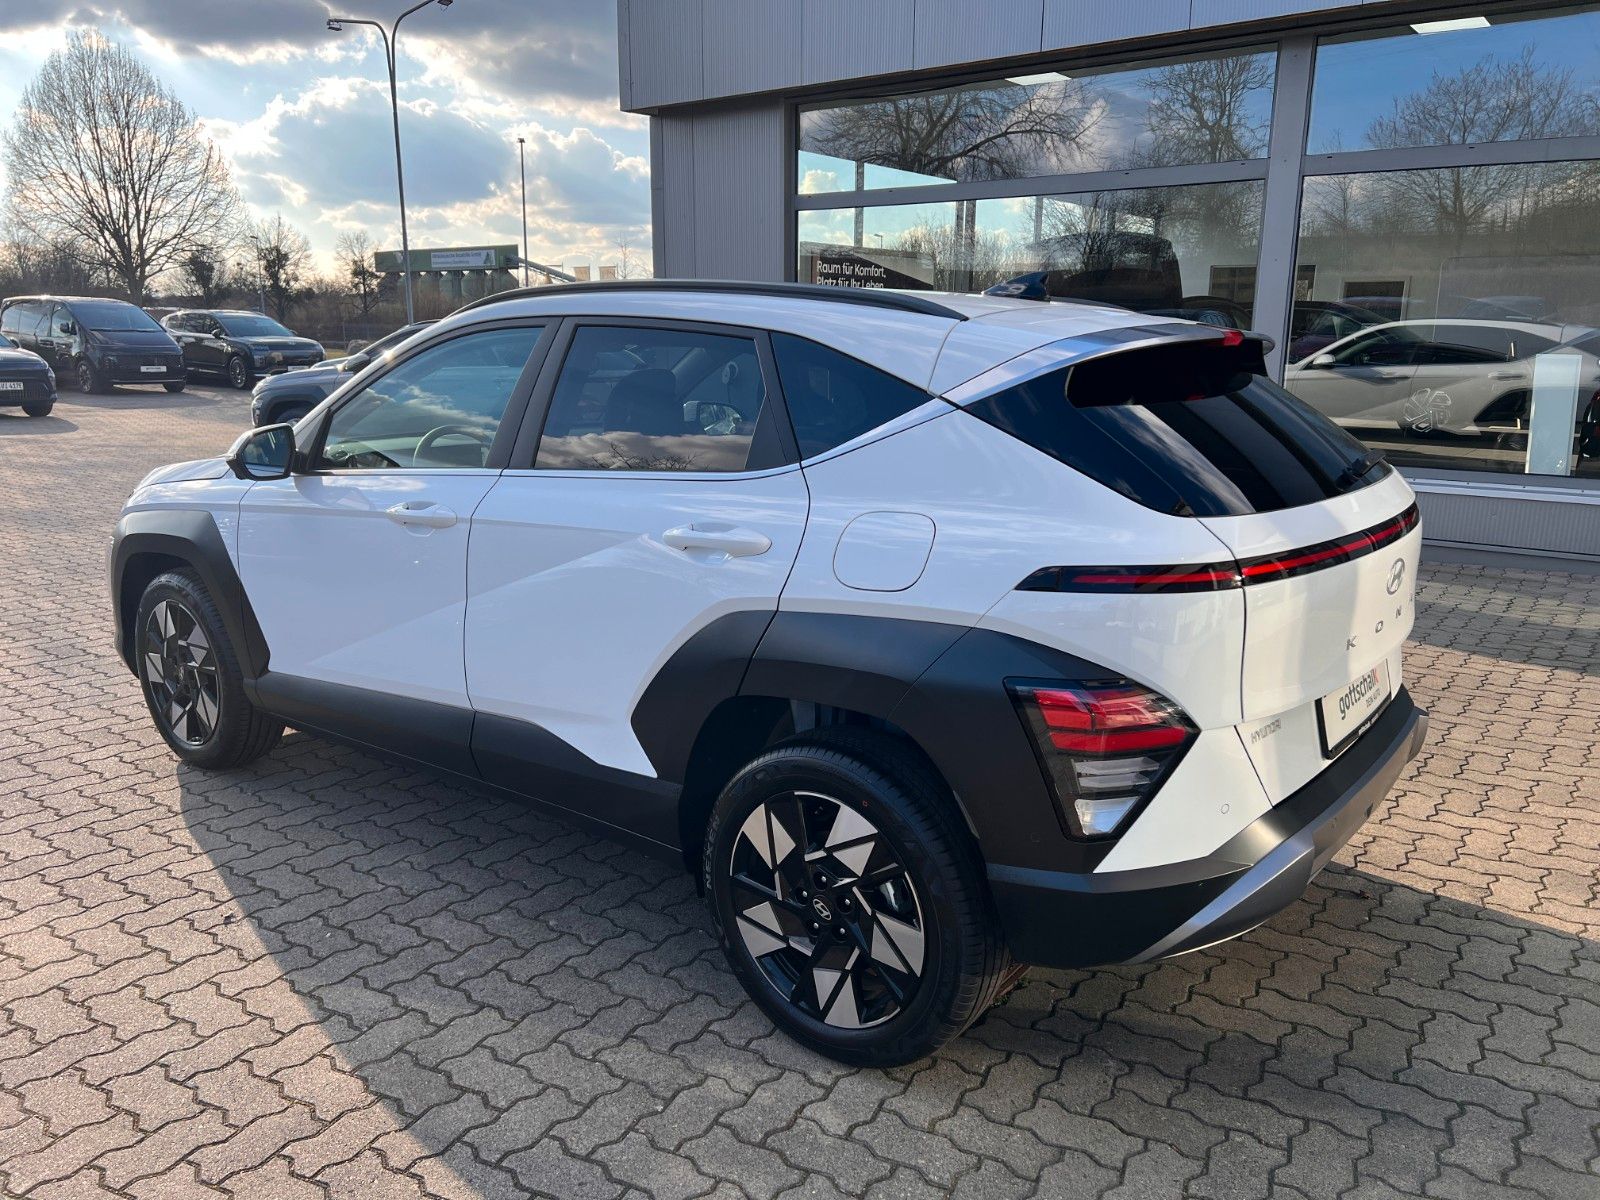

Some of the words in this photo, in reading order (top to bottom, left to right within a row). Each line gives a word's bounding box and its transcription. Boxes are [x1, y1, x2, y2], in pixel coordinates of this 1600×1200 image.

[817, 260, 841, 274] Raum
[842, 262, 853, 275] für
[817, 276, 837, 287] Platz
[838, 277, 849, 287] für
[851, 278, 861, 288] Ihr
